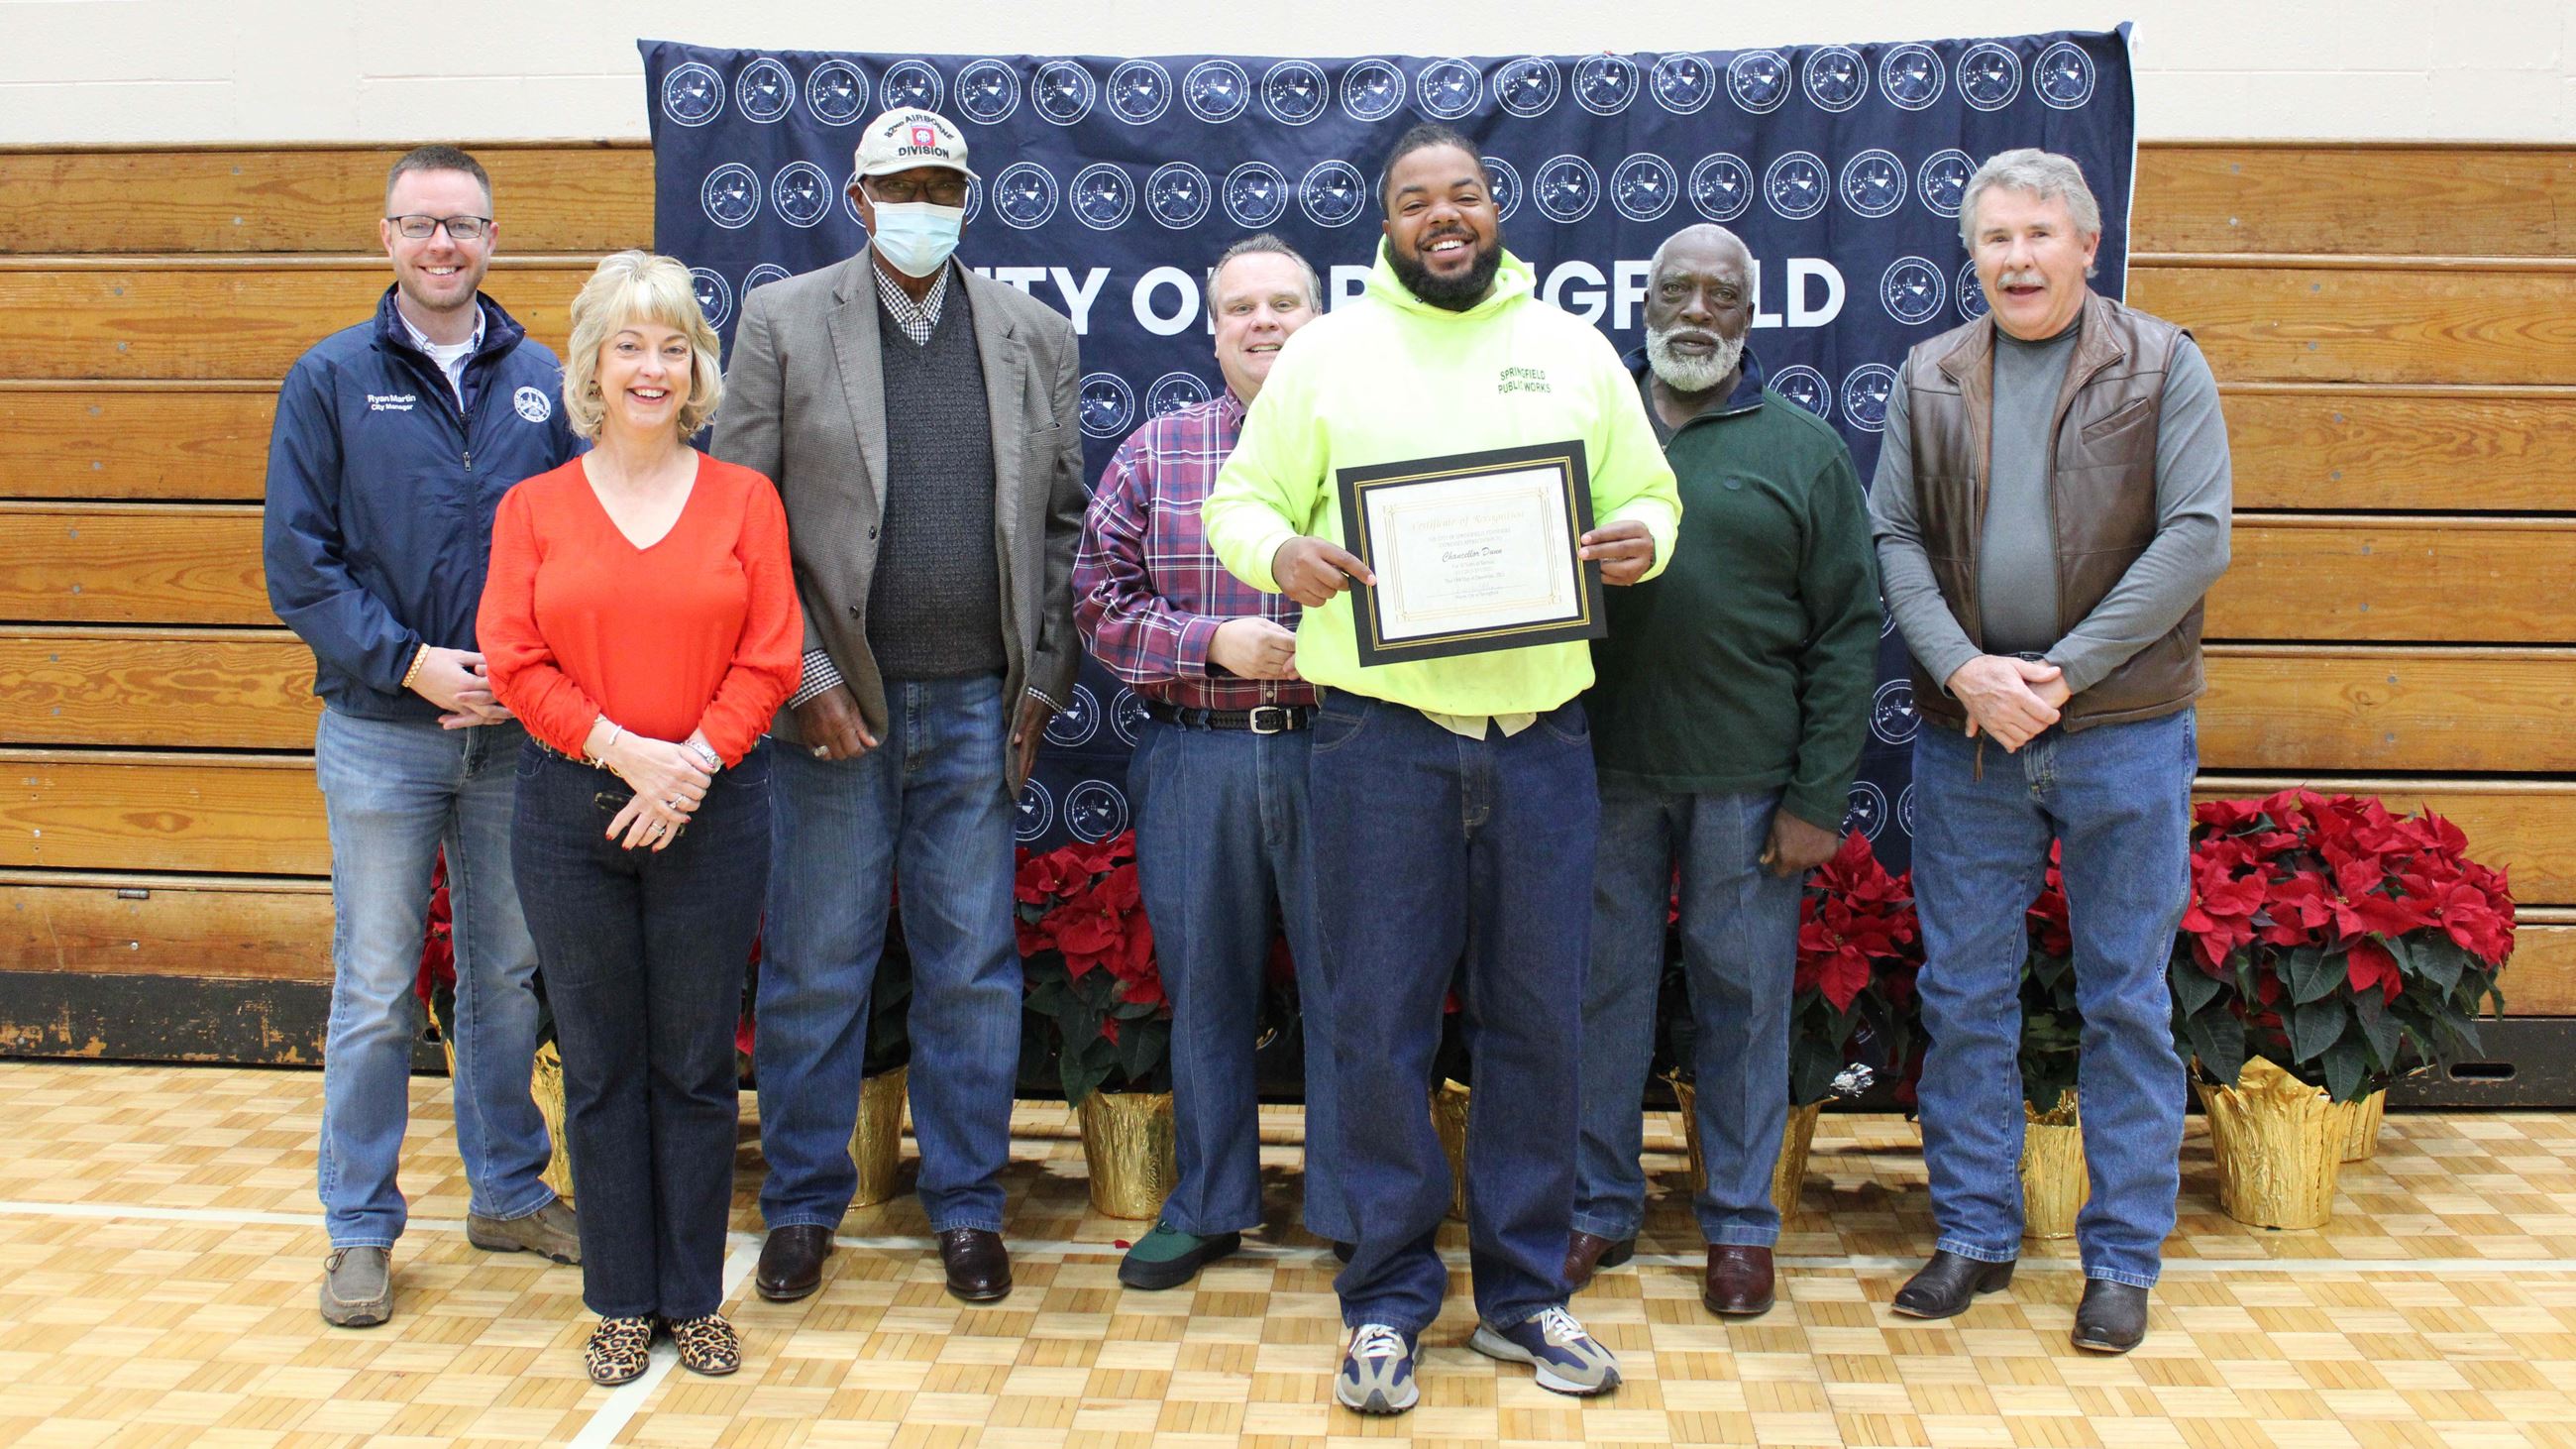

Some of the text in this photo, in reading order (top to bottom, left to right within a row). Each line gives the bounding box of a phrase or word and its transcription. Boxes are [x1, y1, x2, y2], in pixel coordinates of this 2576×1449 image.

[906, 114, 954, 140] AIRBORNE
[899, 146, 949, 159] DIVISION
[1131, 266, 1216, 335] O
[1500, 367, 1546, 381] SPRINGFIELD
[1498, 380, 1552, 394] PUBLIC WORKS
[368, 393, 416, 403] Ryan Martin
[1442, 546, 1502, 563] Chancellor Dunn
